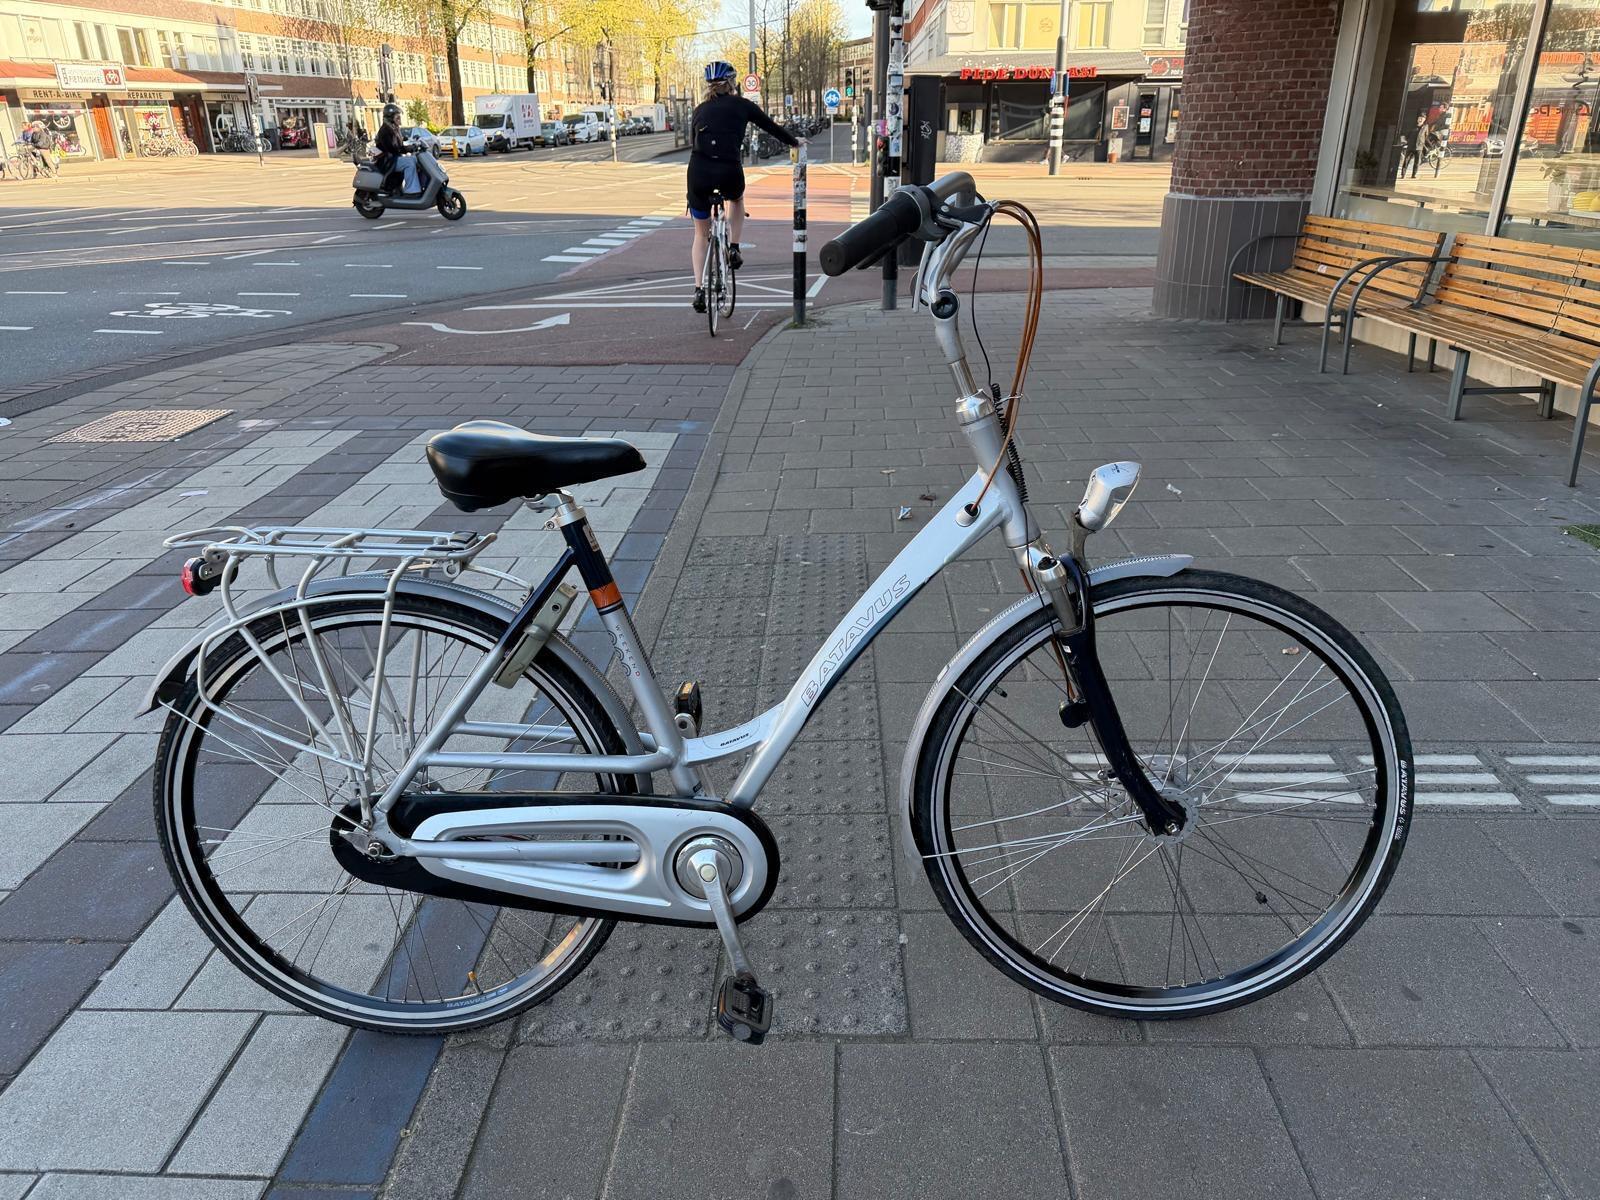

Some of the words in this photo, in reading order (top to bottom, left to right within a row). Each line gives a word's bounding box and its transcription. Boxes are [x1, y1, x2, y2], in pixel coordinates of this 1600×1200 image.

[747, 79, 756, 87] 30
[960, 67, 1010, 80] PIDE
[615, 624, 641, 677] WEEKEND
[801, 575, 911, 707] BATAVUS
[720, 733, 749, 746] BATAVUS
[1400, 760, 1408, 815] BATAVUS
